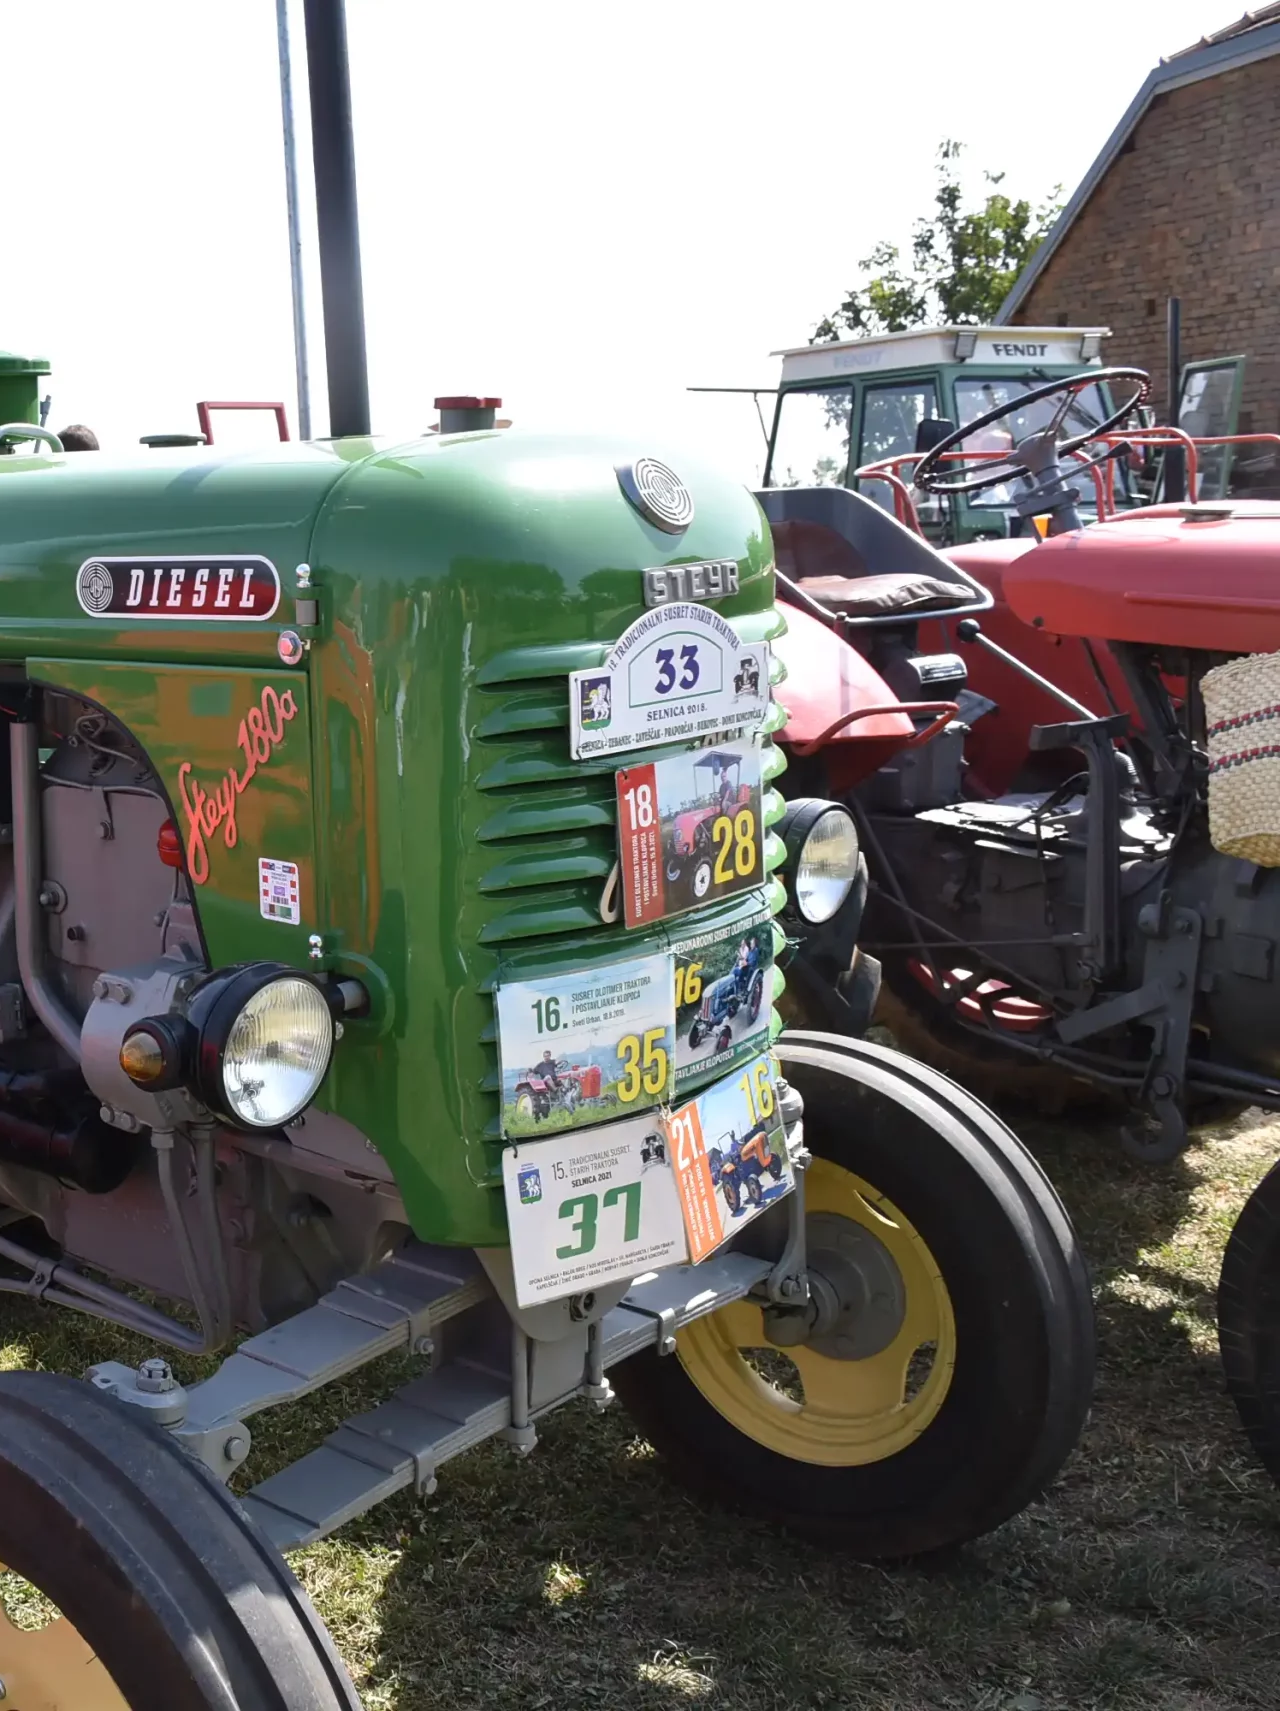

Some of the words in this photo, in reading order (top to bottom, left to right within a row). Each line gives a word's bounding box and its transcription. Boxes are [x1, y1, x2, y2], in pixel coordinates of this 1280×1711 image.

[992, 343, 1048, 357] FENDT
[126, 569, 255, 608] DIESEL
[648, 561, 738, 603] STEYR
[614, 610, 663, 660] TRADICIONALNI
[664, 605, 689, 621] SUSRET
[690, 606, 713, 625] STARIH
[711, 616, 740, 651] TRAKTORA
[654, 644, 701, 695] 33
[646, 705, 685, 721] SELNICA
[178, 762, 246, 885] Steyr
[624, 784, 657, 830] 18.
[631, 834, 639, 865] TRAKTORA
[712, 809, 756, 884] 28
[633, 865, 641, 894] OLDTIMER
[634, 895, 642, 918] SUSRET
[571, 989, 594, 1003] SUSRET
[594, 982, 623, 1000] OLDTIMER
[623, 975, 651, 992] TRAKTORA
[575, 996, 616, 1014] POSTAVLJANJE
[616, 989, 641, 1006] KLOPOCA
[675, 961, 703, 1009] 16
[531, 996, 568, 1034] 16.
[572, 1018, 586, 1028] Sveti
[616, 1027, 667, 1102] 35
[674, 1061, 705, 1080] TAVLJANJE
[738, 1061, 774, 1126] 16
[672, 1109, 703, 1171] 21.
[551, 1161, 568, 1181] 15.
[569, 1149, 610, 1166] TRADICIONALNI
[569, 1165, 590, 1177] STARIH
[591, 1158, 619, 1171] TRAKTORA
[571, 1175, 597, 1188] SELNICA
[597, 1171, 613, 1182] 2021
[556, 1181, 641, 1260] 37
